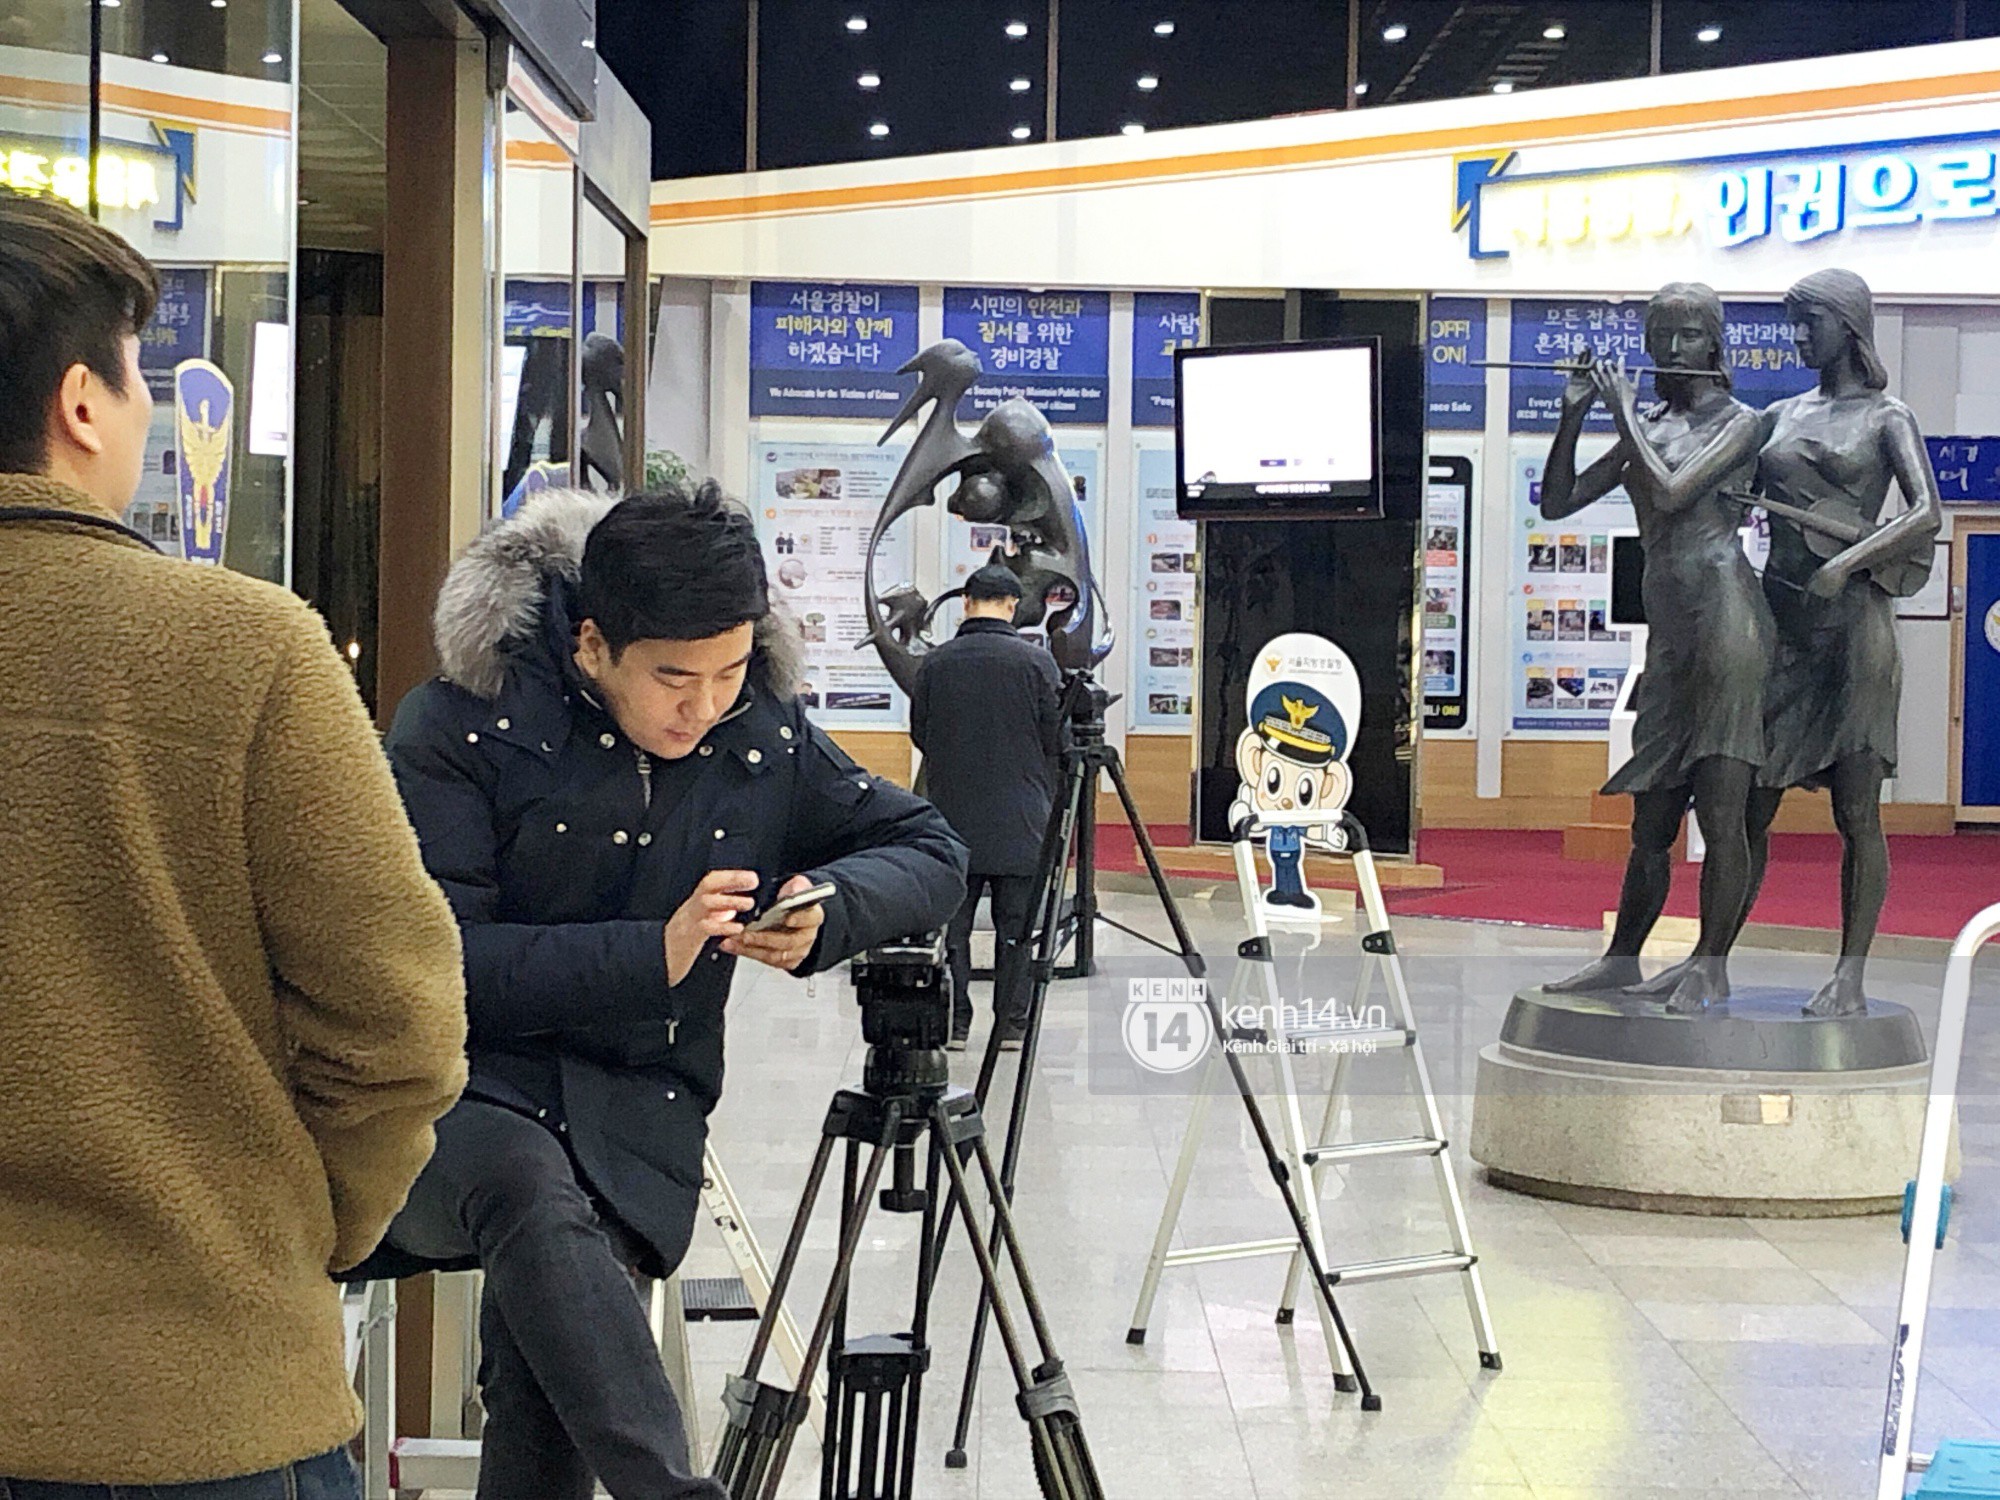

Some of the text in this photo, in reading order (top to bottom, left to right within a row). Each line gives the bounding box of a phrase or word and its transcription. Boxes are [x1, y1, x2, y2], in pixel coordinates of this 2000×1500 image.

[1705, 149, 2000, 249] 인권으로
[790, 290, 880, 314] 서울경찰이
[971, 295, 1083, 319] 시민의 안전과
[775, 315, 893, 340] 피해자와 함께
[1159, 312, 1200, 335] 사람
[1431, 320, 1470, 340] OFF!
[1544, 308, 1639, 330] 모든 접촉은
[978, 321, 1074, 345] 질서를 위한
[1534, 332, 1588, 355] 흔적을
[788, 341, 881, 365] 하겠습니다
[991, 347, 1062, 370] 경비경찰
[1432, 345, 1467, 364] ON!
[1724, 348, 1806, 371] 12통합지
